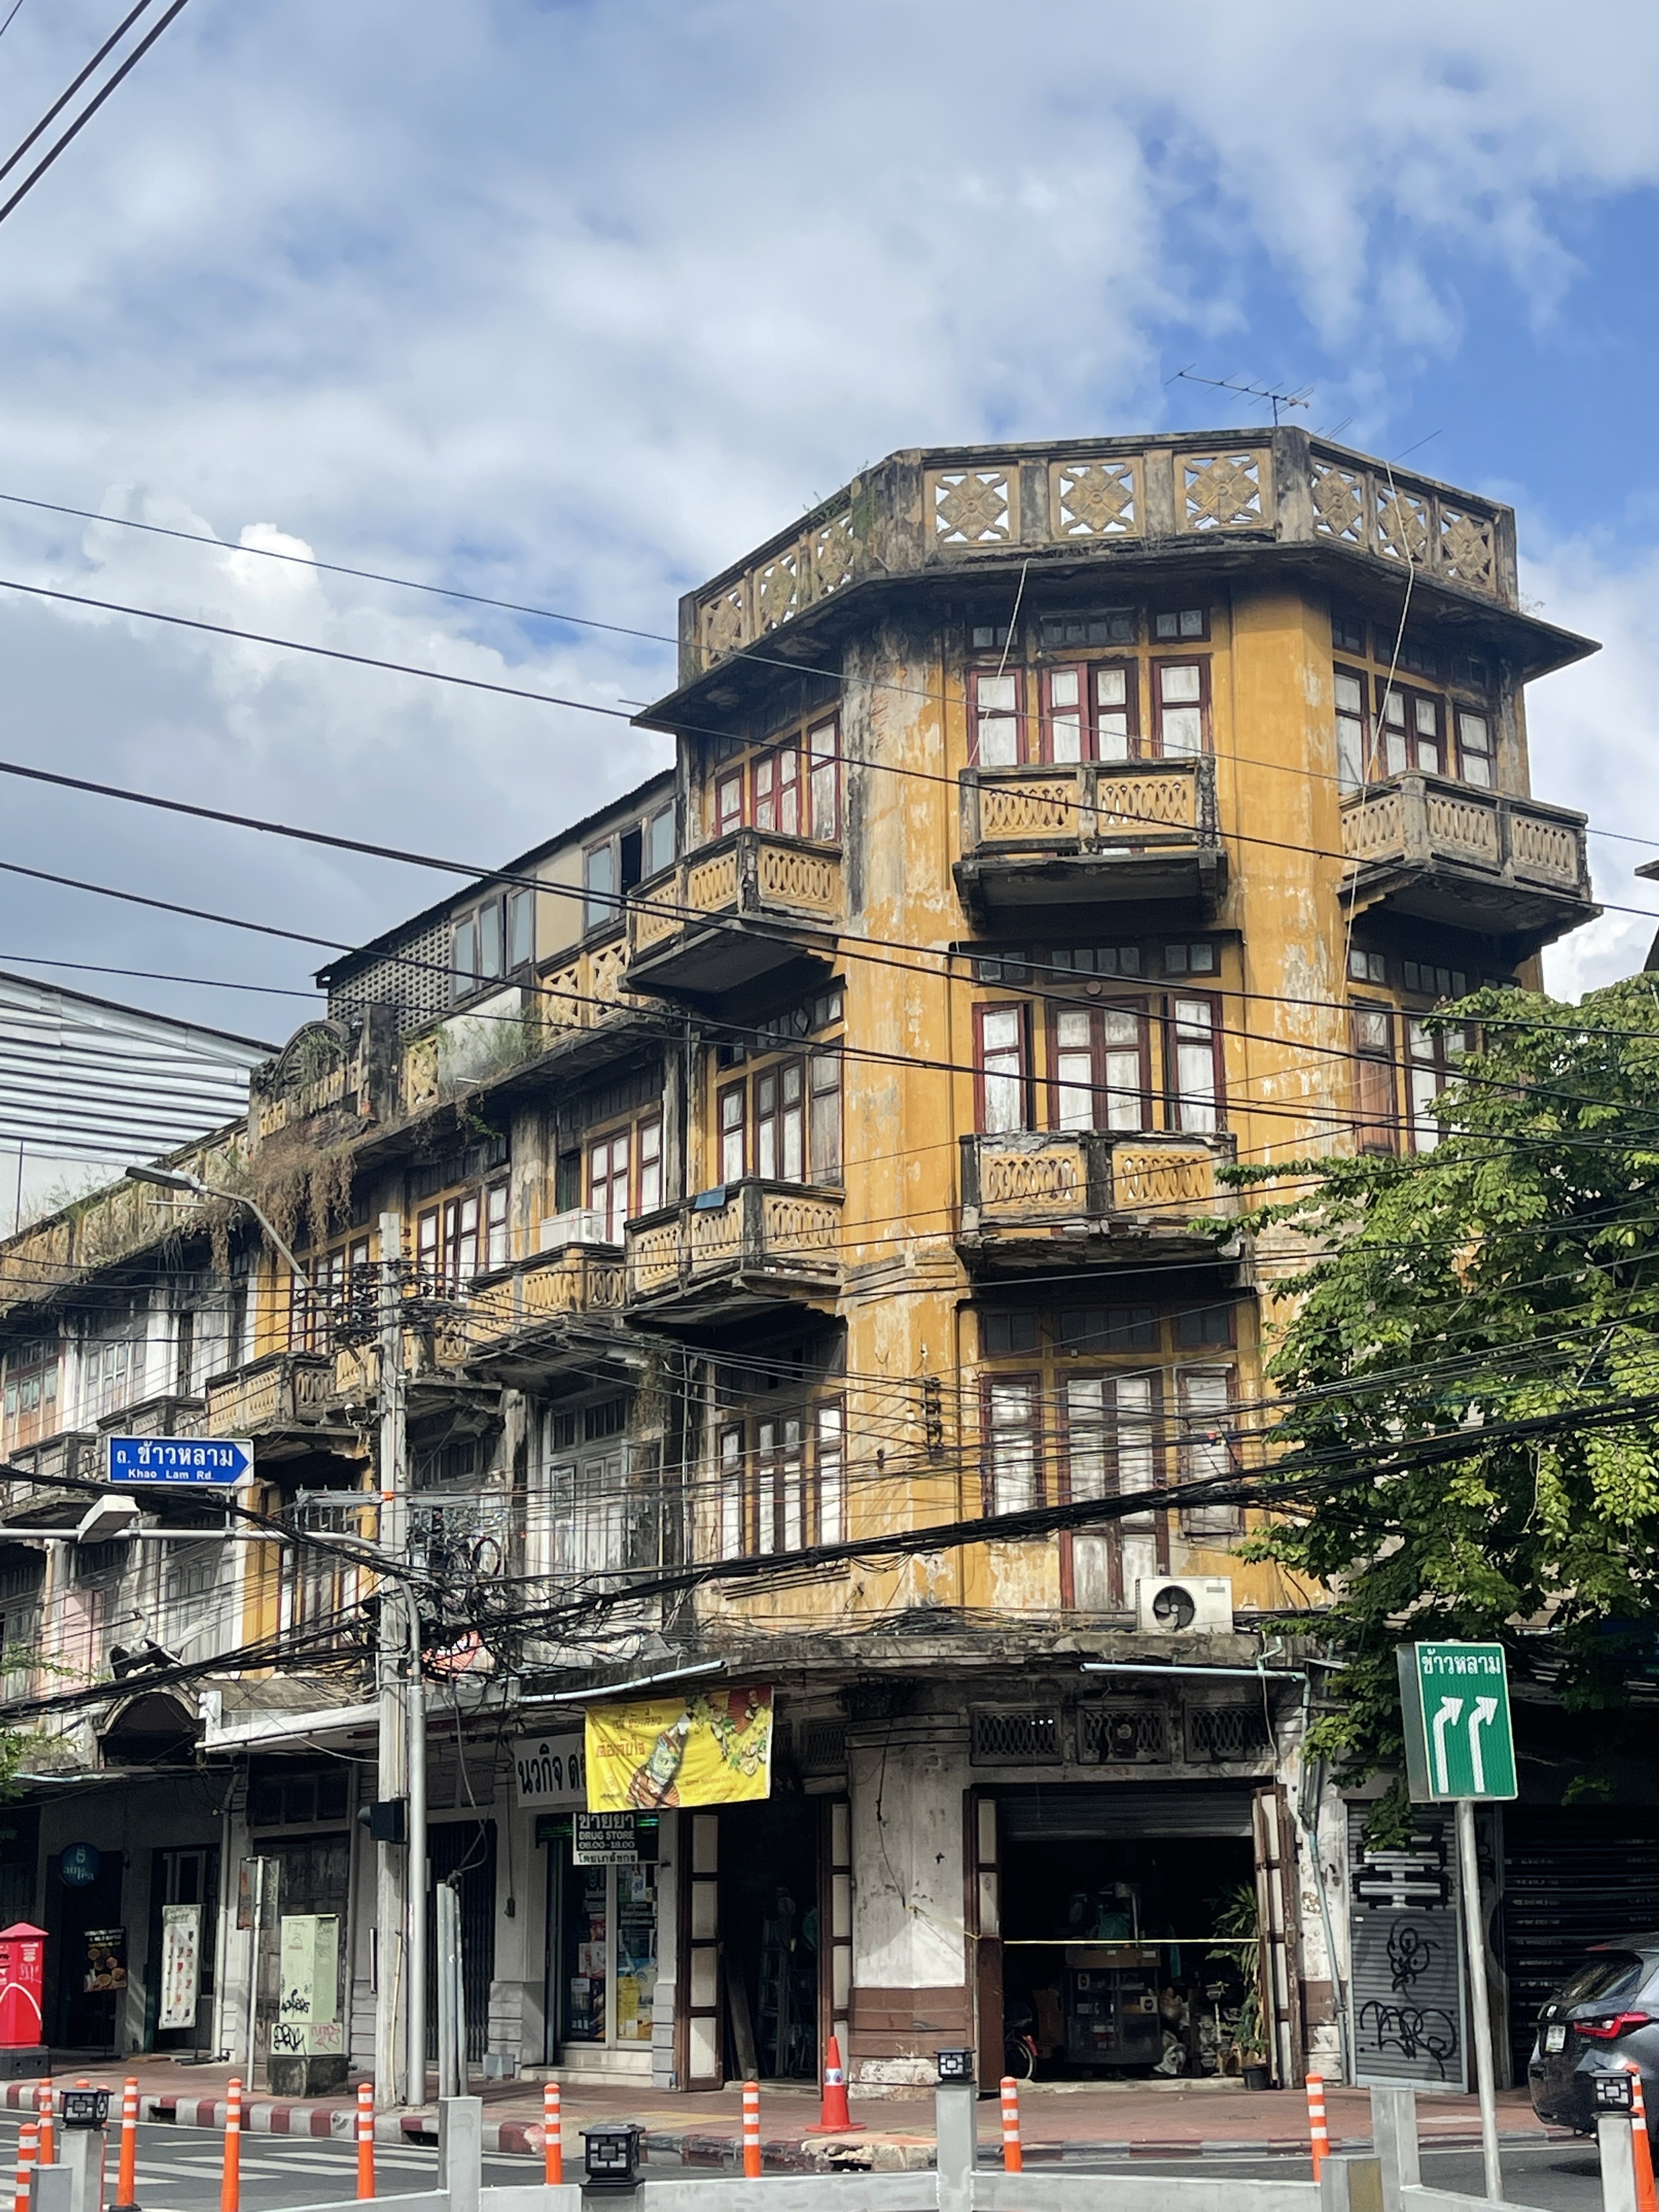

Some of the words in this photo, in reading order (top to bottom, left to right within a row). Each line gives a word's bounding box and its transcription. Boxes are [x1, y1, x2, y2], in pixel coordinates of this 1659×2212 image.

[116, 1449, 131, 1464] ถ.
[137, 1441, 233, 1467] ข้าวหลาม
[128, 1468, 157, 1479] Khao
[166, 1470, 189, 1480] Lam
[1421, 1647, 1502, 1674] ข้าวหลาม
[517, 1742, 563, 1795] นวกิจ
[578, 1814, 635, 1829] ขายยา
[578, 1831, 604, 1841] DRUG
[605, 1830, 635, 1840] STORE
